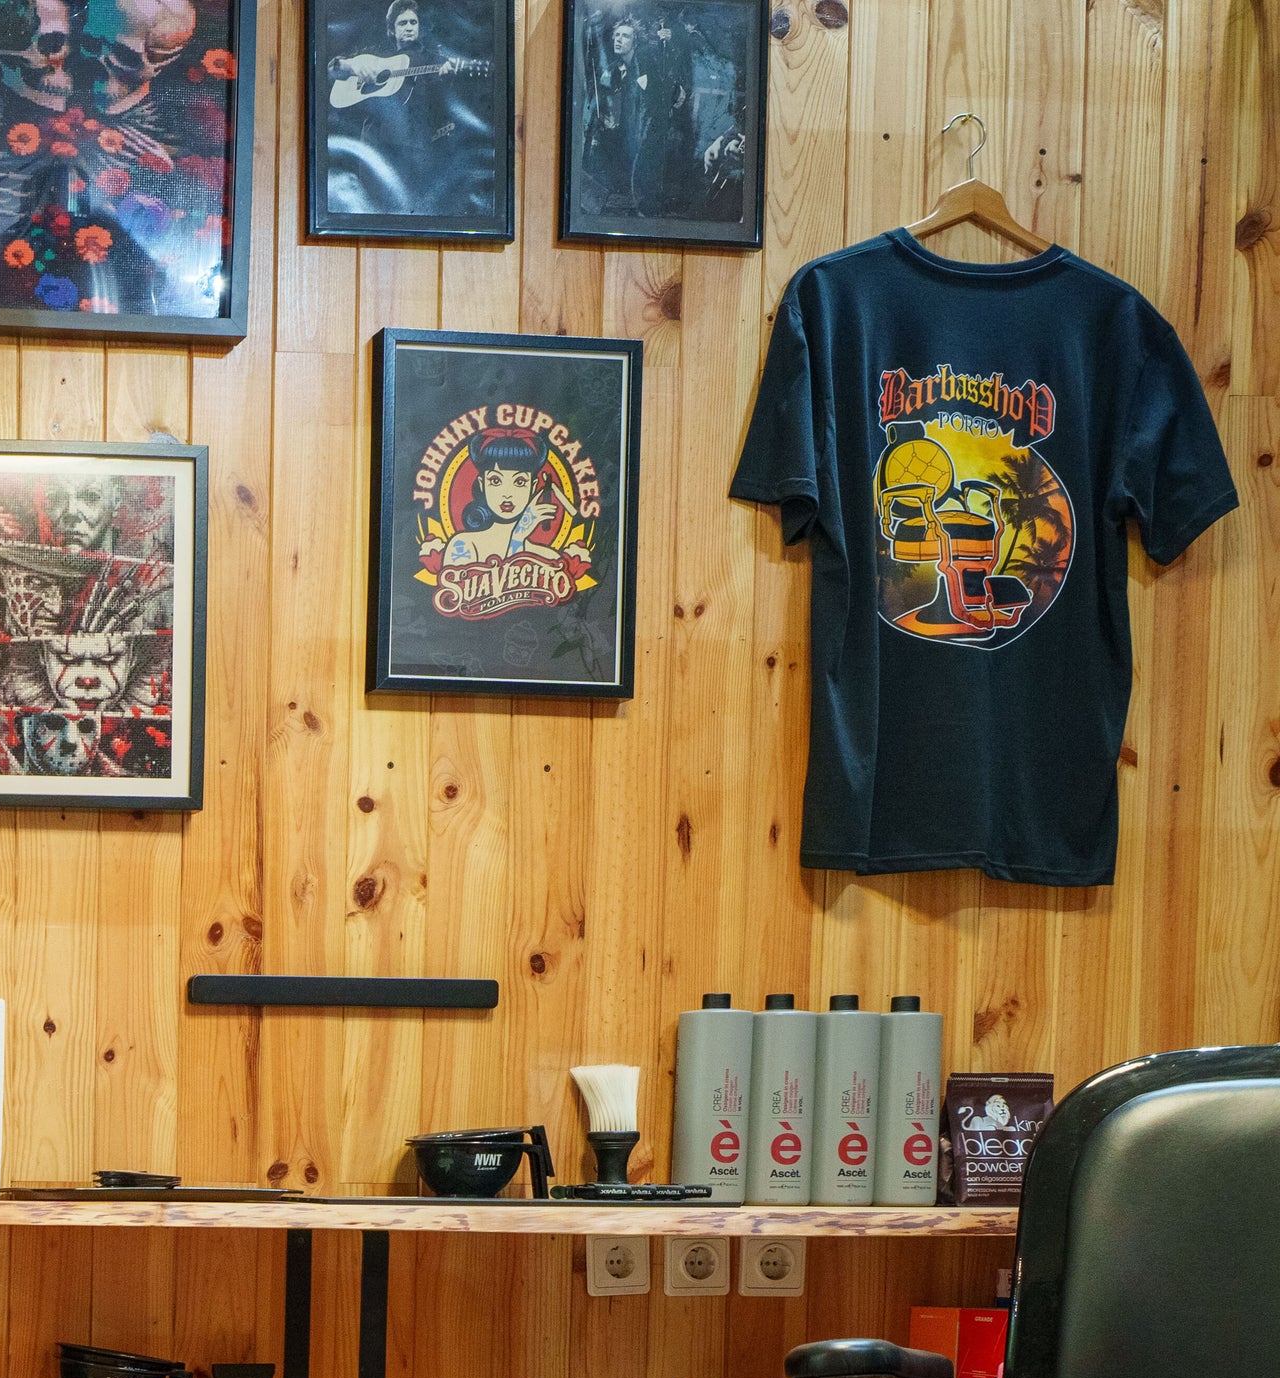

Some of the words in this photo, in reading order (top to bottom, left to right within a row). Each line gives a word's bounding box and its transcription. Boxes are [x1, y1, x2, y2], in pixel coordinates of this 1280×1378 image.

[938, 412, 999, 438] PORTO
[413, 405, 488, 510] JOHNNY
[496, 403, 601, 519] CUPCAKES
[434, 559, 572, 613] SUAVECITO
[479, 591, 531, 612] POMADE
[713, 1087, 722, 1112] CREA
[772, 1090, 781, 1114] CREA
[841, 1090, 850, 1114] CREA
[906, 1091, 914, 1115] CREA
[710, 1120, 740, 1163] è
[770, 1121, 802, 1165] è
[837, 1122, 868, 1166] è
[903, 1122, 933, 1166] è
[961, 1131, 1034, 1157] bleac
[474, 1153, 502, 1166] NVNT
[966, 1160, 1024, 1176] powder
